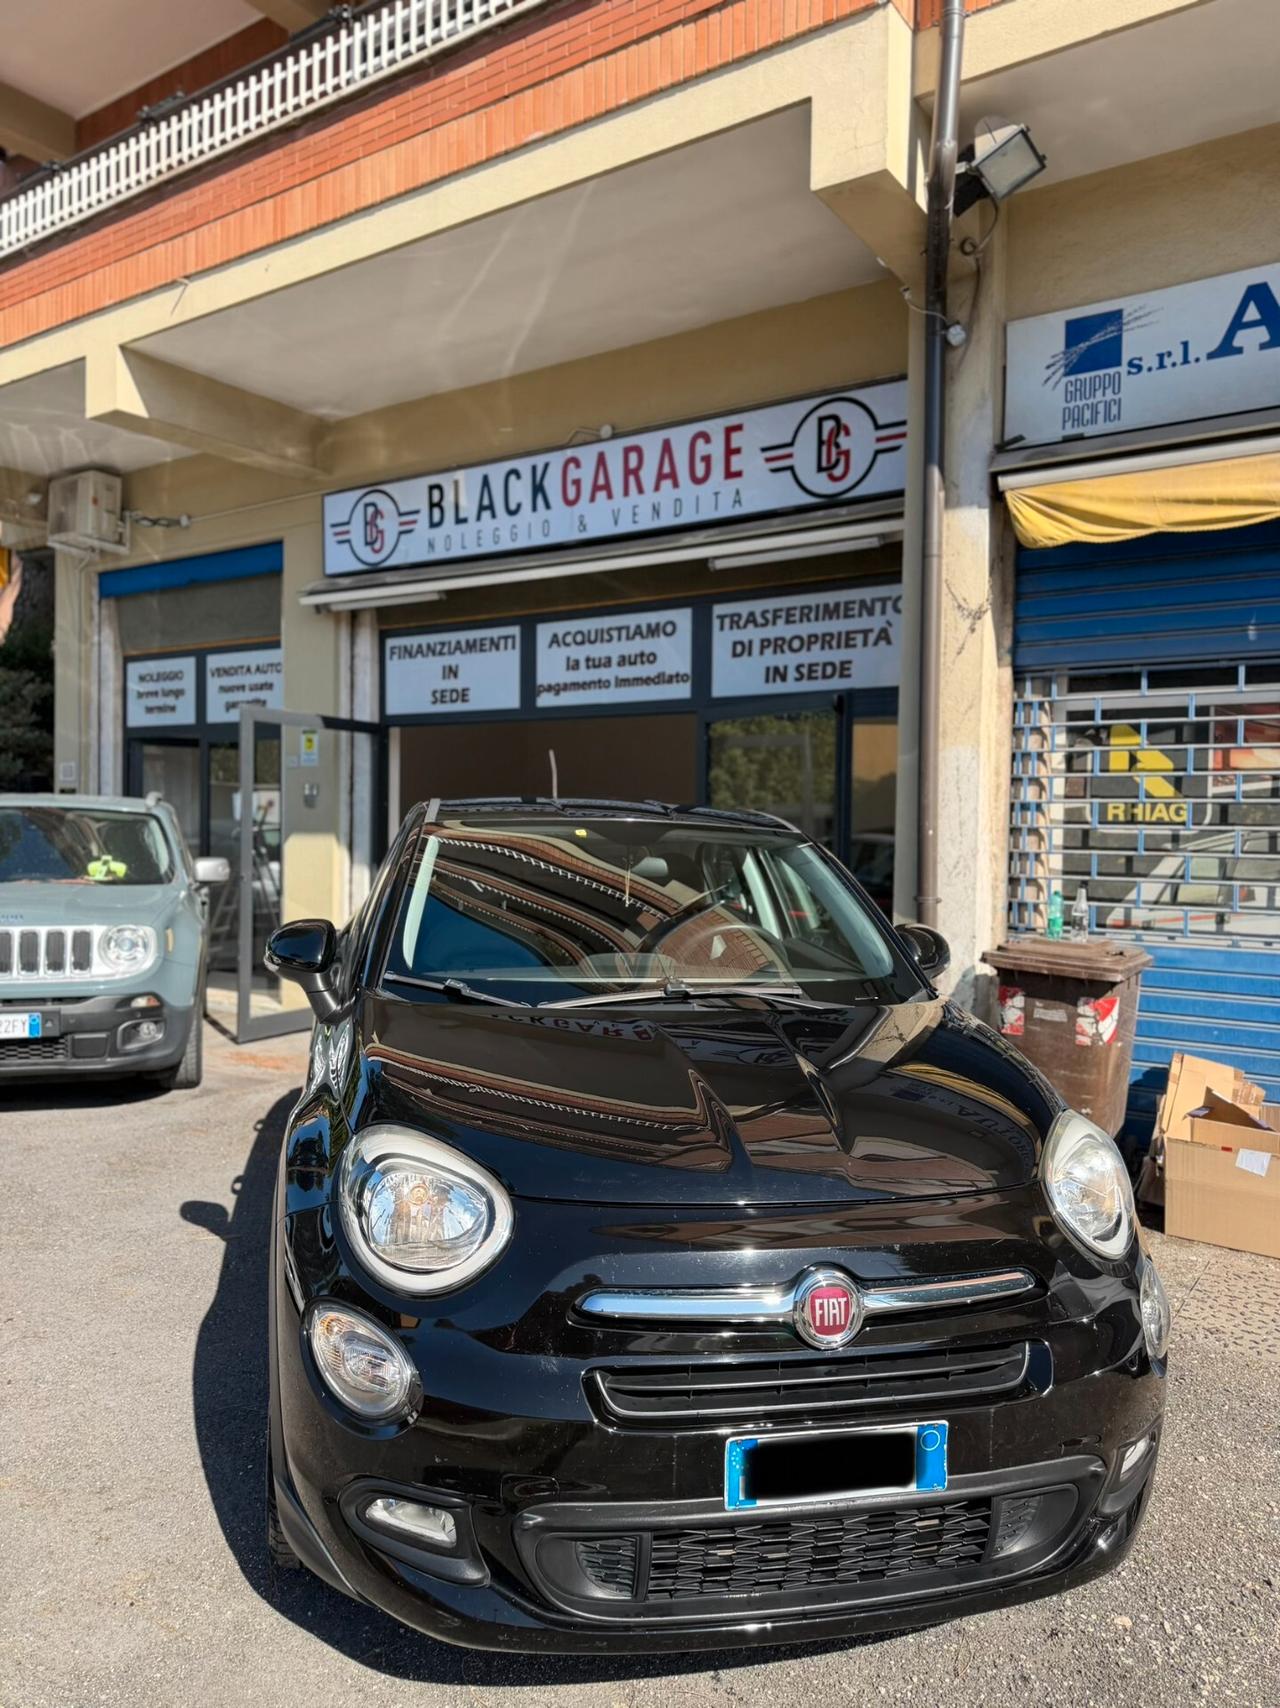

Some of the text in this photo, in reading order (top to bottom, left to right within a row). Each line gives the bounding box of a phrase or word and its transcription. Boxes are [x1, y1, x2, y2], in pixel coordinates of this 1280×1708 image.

[1127, 340, 1200, 377] s.r.l.
[1064, 370, 1122, 405] GRUPPO
[1061, 397, 1122, 431] PACIFICI
[427, 488, 743, 555] NOLEGGIO & VENDITA
[389, 634, 517, 661] FINANZIAMENTI
[547, 619, 678, 649] ACQUISTIAMO
[731, 619, 893, 659] DI PROPRIETÀ
[209, 664, 251, 679] VENDITA
[441, 664, 459, 681] IN
[565, 650, 658, 671] la tua auto
[764, 659, 853, 684] IN SEDE
[430, 687, 471, 706] SEDE
[536, 677, 611, 698] pagamento
[1106, 802, 1187, 822] RHIAG
[815, 1296, 848, 1327] FIAT
